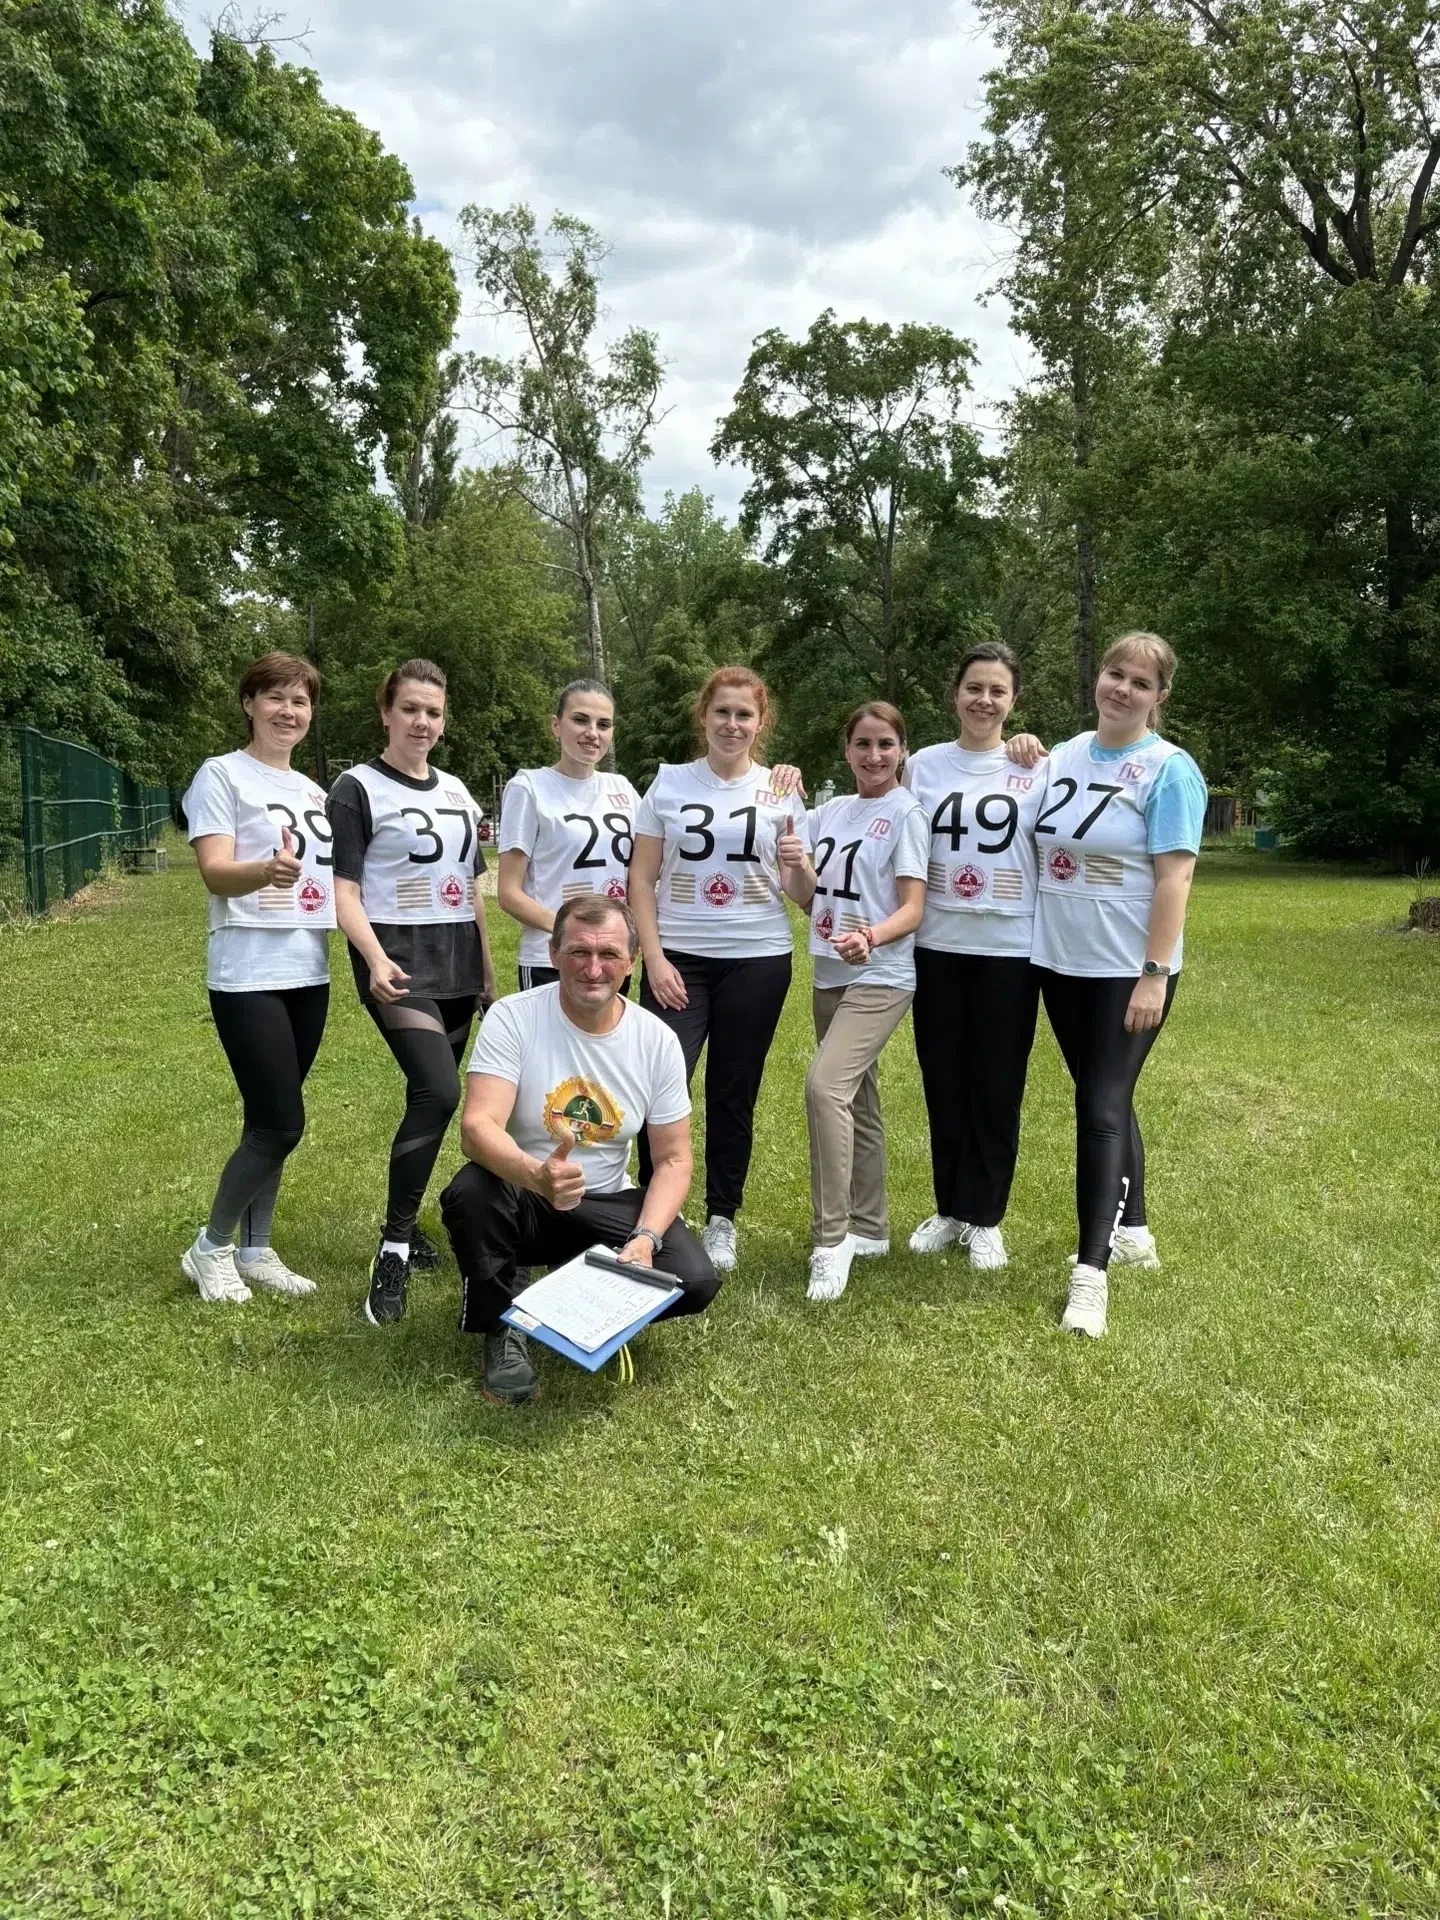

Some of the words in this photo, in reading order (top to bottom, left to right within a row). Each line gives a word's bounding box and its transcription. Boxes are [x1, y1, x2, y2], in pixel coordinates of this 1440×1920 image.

[400, 807, 472, 864] 37
[679, 803, 760, 864] 31
[931, 792, 1018, 854] 49
[1034, 777, 1124, 840] 27
[563, 813, 634, 870] 28
[815, 836, 863, 901] 21
